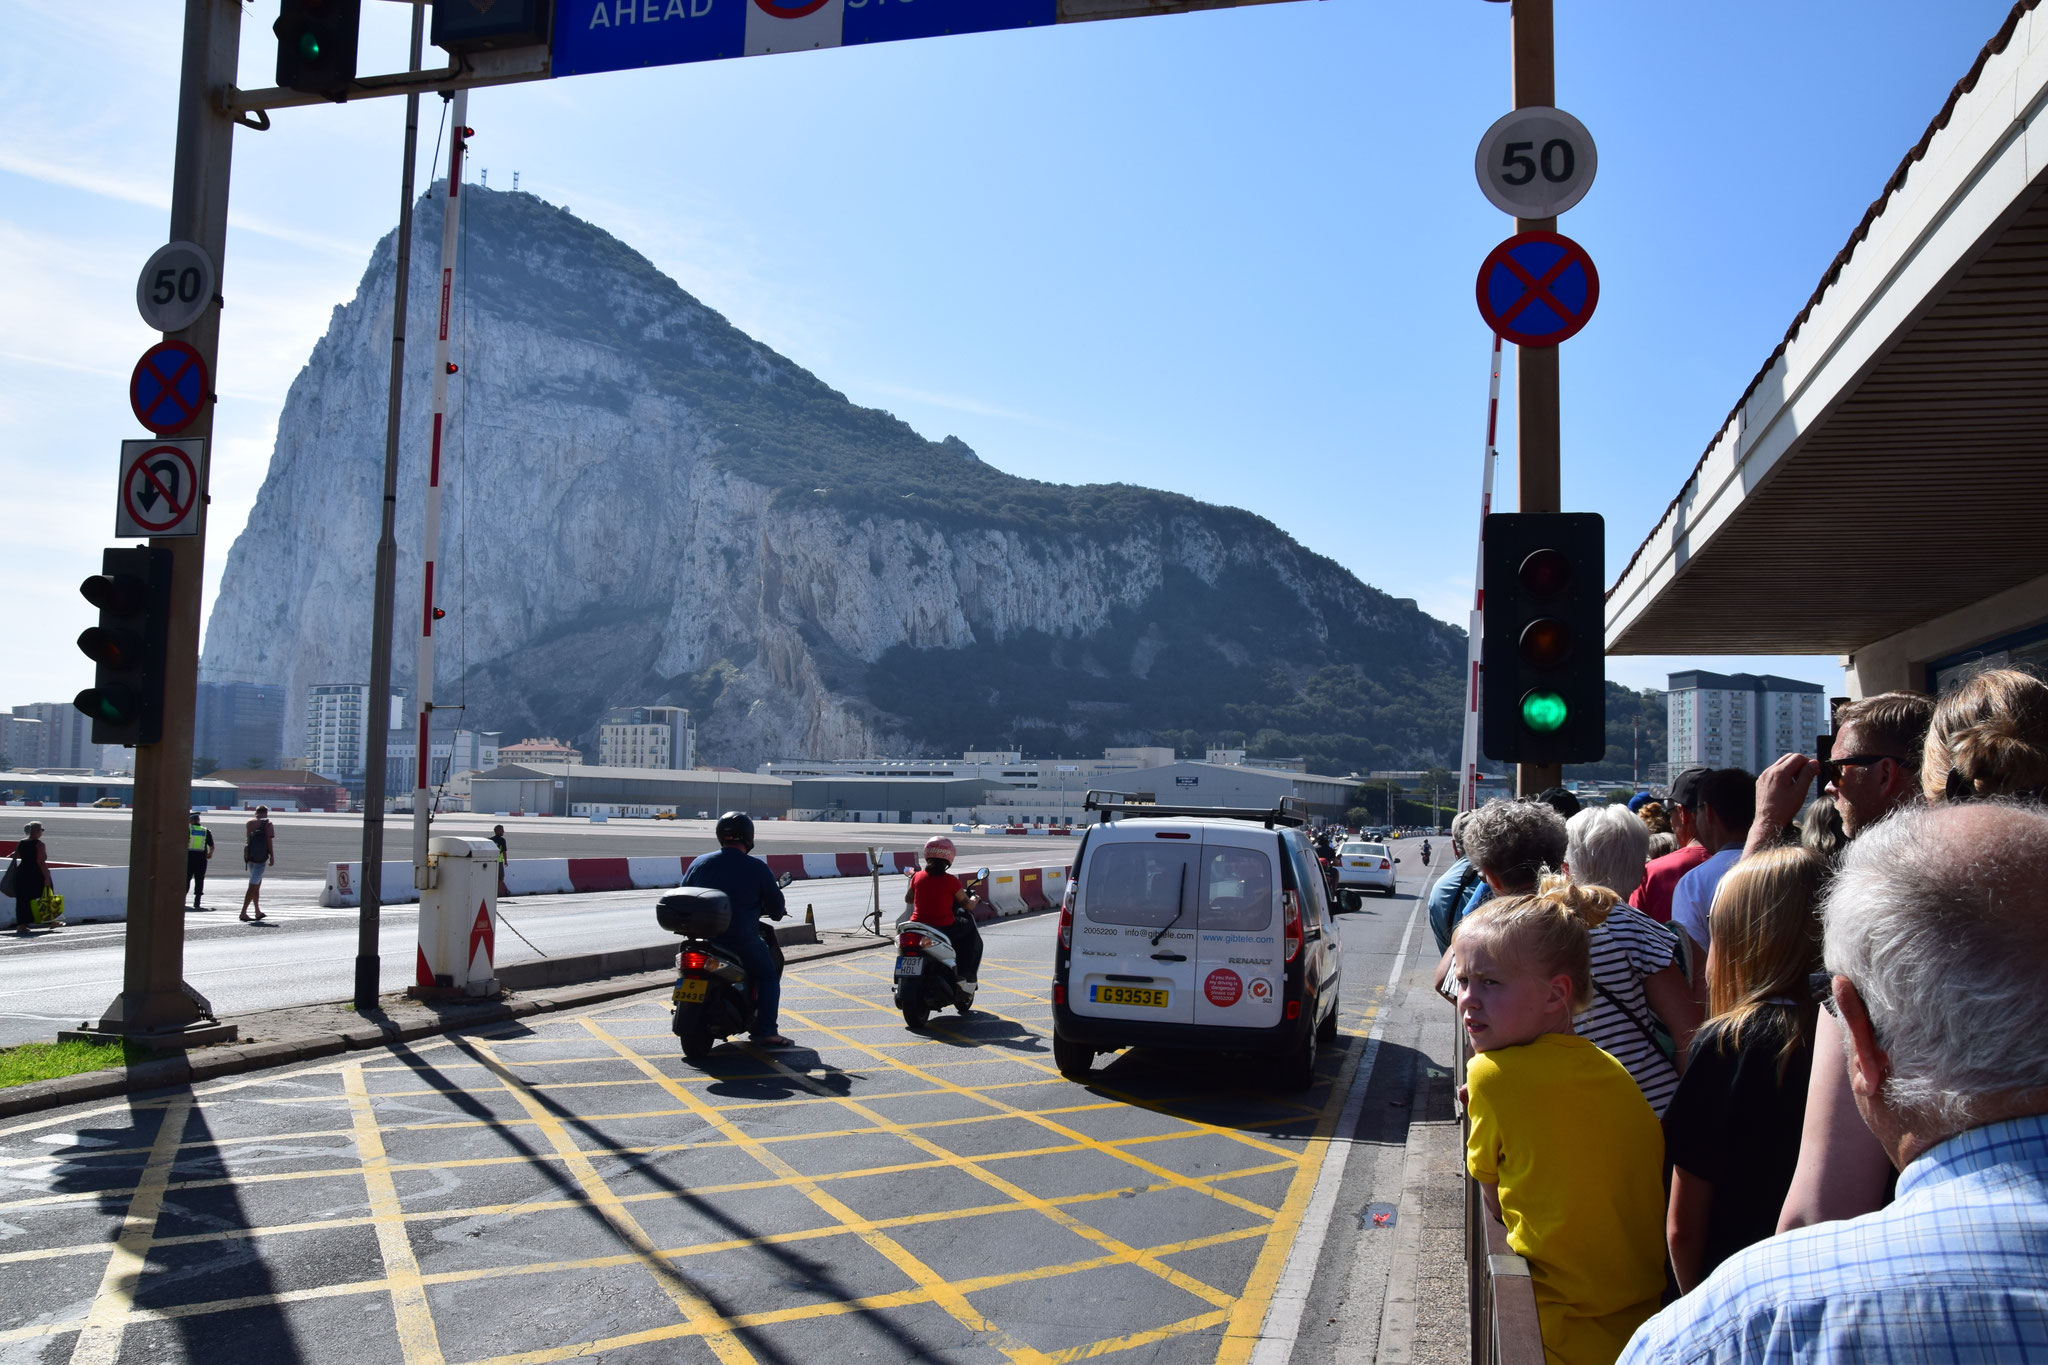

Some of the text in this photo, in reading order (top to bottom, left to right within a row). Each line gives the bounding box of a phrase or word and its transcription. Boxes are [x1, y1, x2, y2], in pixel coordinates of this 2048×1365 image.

[589, 0, 713, 30] AHEAD
[1501, 138, 1574, 186] 50
[153, 267, 201, 305] 50
[1083, 927, 1194, 940] 20052200 info@gibele.com
[1202, 934, 1274, 944] www.gibtele.com
[1228, 957, 1273, 965] RENAULT
